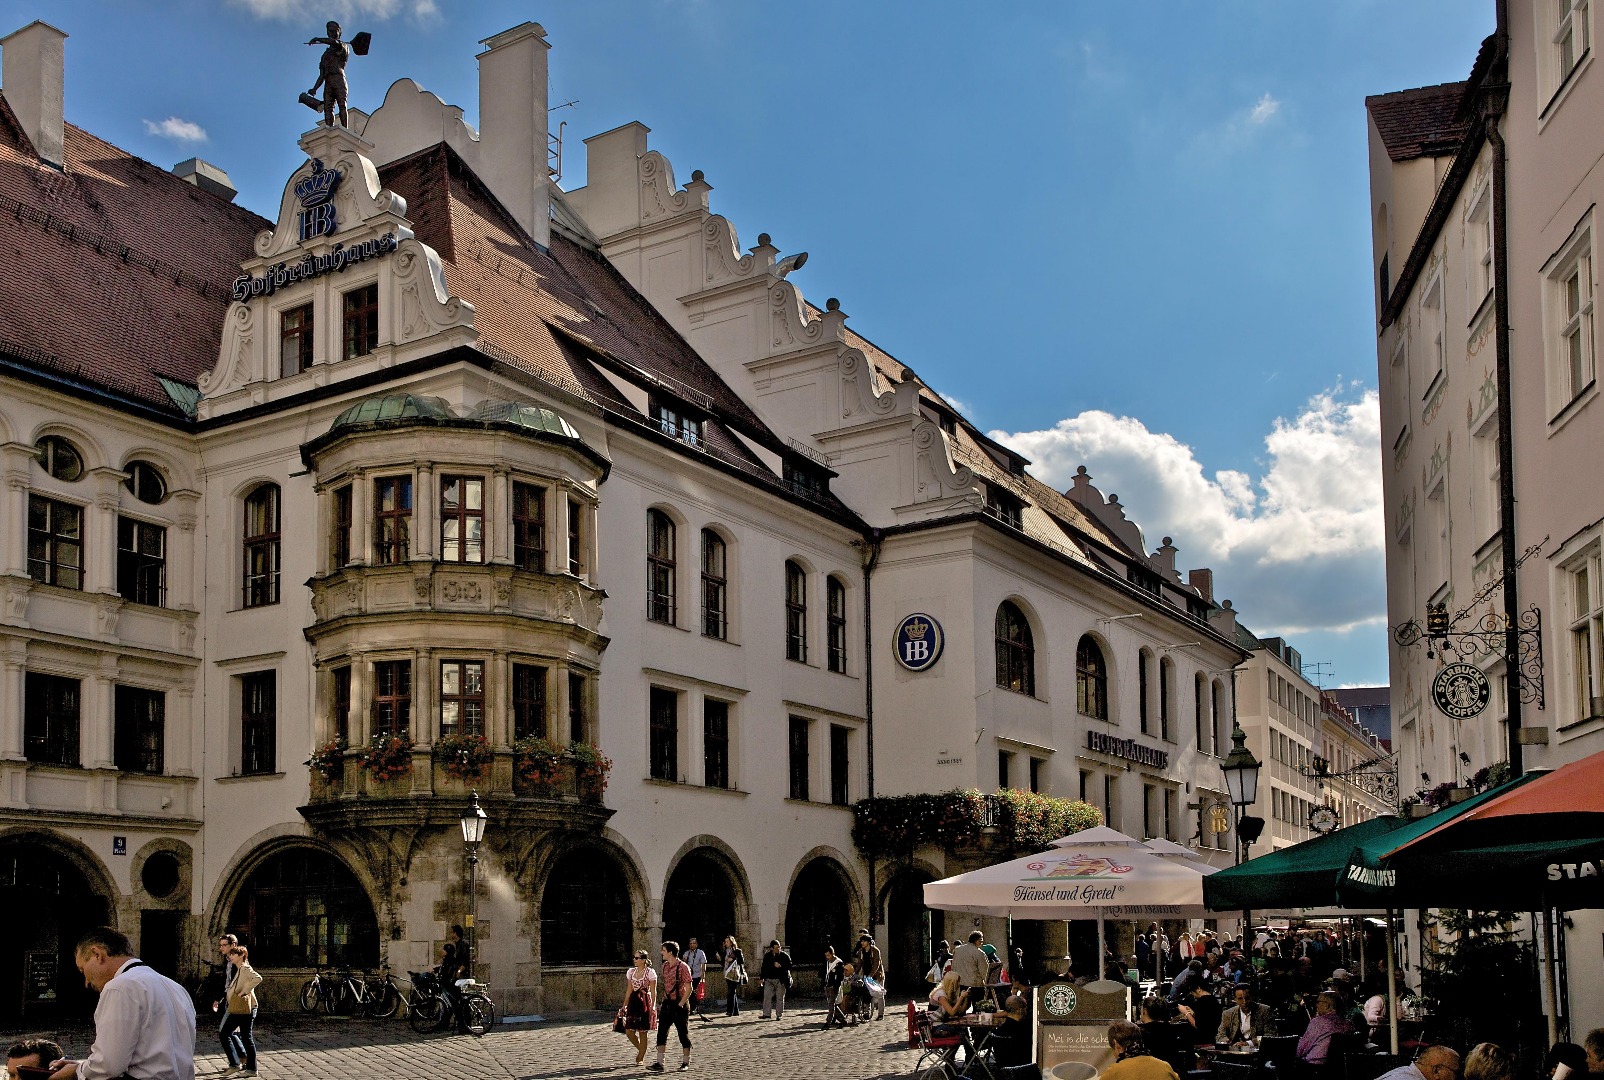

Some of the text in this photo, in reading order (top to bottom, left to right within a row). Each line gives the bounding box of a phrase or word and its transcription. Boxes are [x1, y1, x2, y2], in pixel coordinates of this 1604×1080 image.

[298, 203, 337, 241] HB
[233, 232, 397, 303] Hofbräuhaus
[904, 640, 929, 662] HB
[1437, 665, 1486, 693] STARBUCKS
[1447, 699, 1485, 717] COFFEE
[1088, 731, 1169, 770] HOFBRÄUHAUS
[1211, 818, 1228, 833] HB
[117, 838, 123, 847] 9
[1013, 885, 1117, 904] Hänsel und Gretel
[1046, 986, 1075, 999] STARBUCKS
[1049, 1006, 1071, 1015] COFFEE
[1048, 1032, 1109, 1044] Mei is die sche
